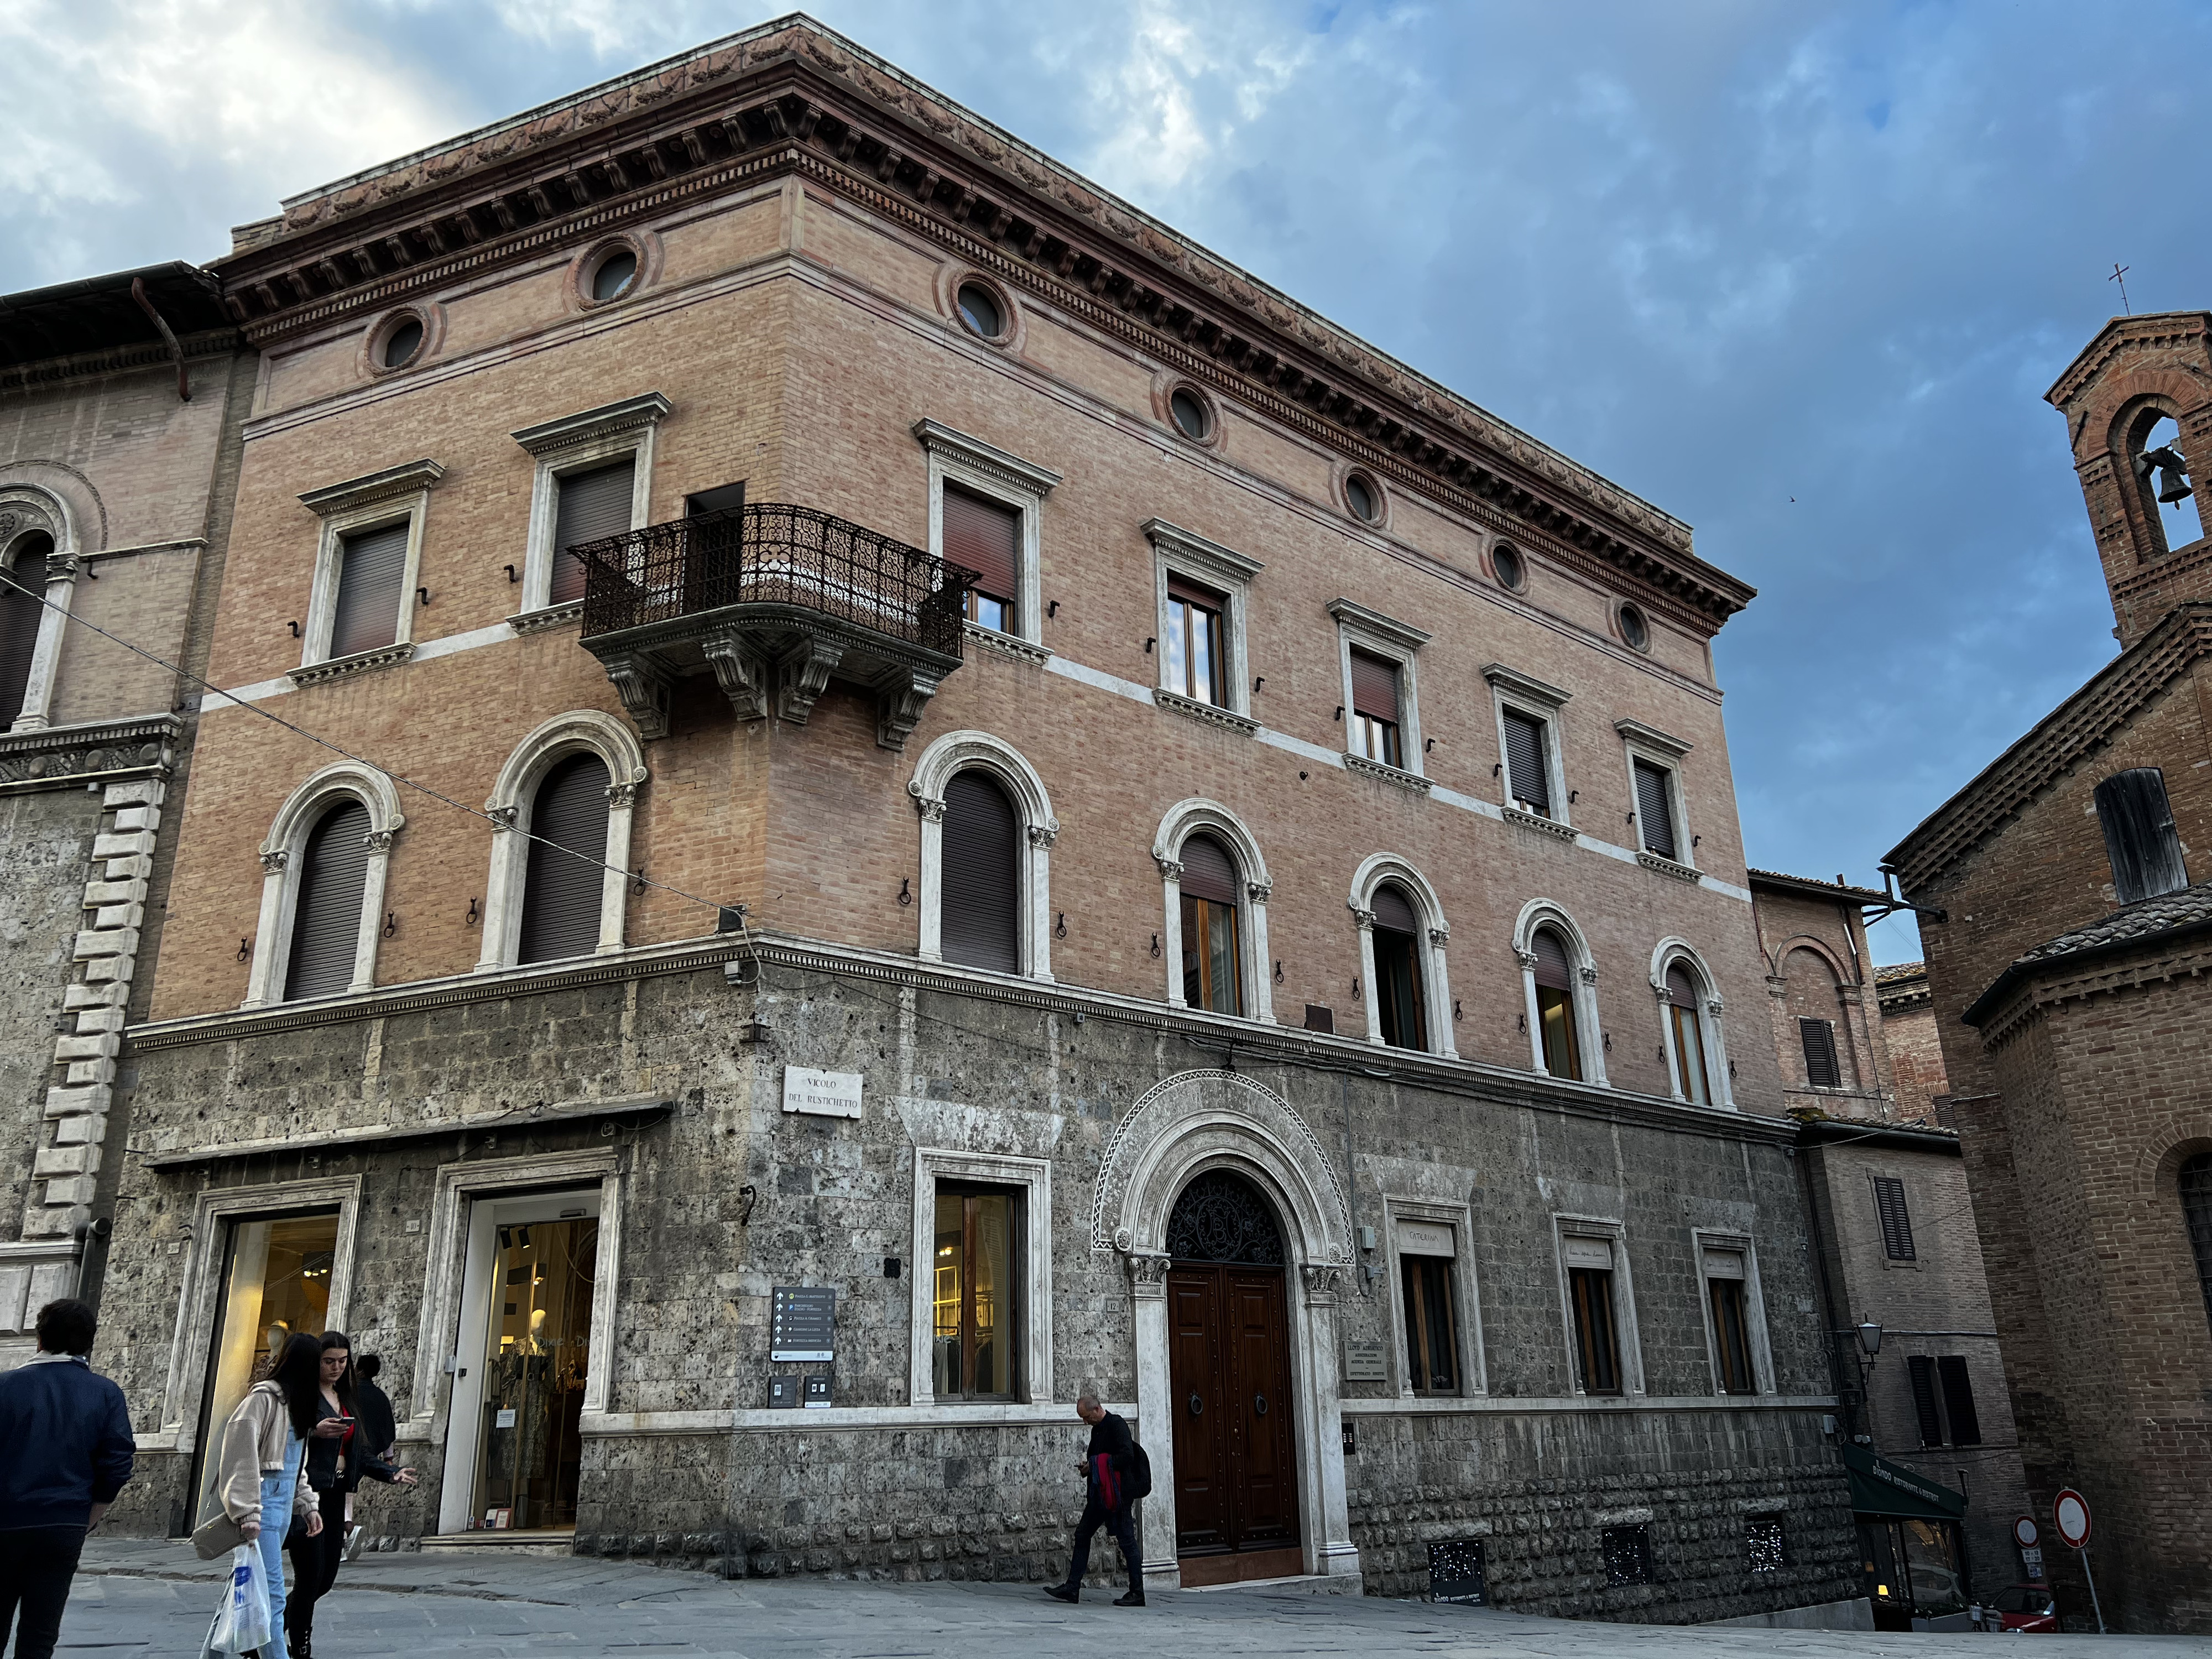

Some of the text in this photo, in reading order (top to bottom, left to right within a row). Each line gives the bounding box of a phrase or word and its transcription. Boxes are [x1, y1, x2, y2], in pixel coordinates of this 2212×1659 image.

[807, 1078, 836, 1089] VICOLO
[789, 1093, 858, 1108] DEL RUSTICHETTO
[1409, 1231, 1439, 1242] CATERINA
[1872, 1465, 1892, 1481] BIONDO
[1893, 1476, 1918, 1494] RISTORANTE
[1922, 1489, 1939, 1502] BISTROT
